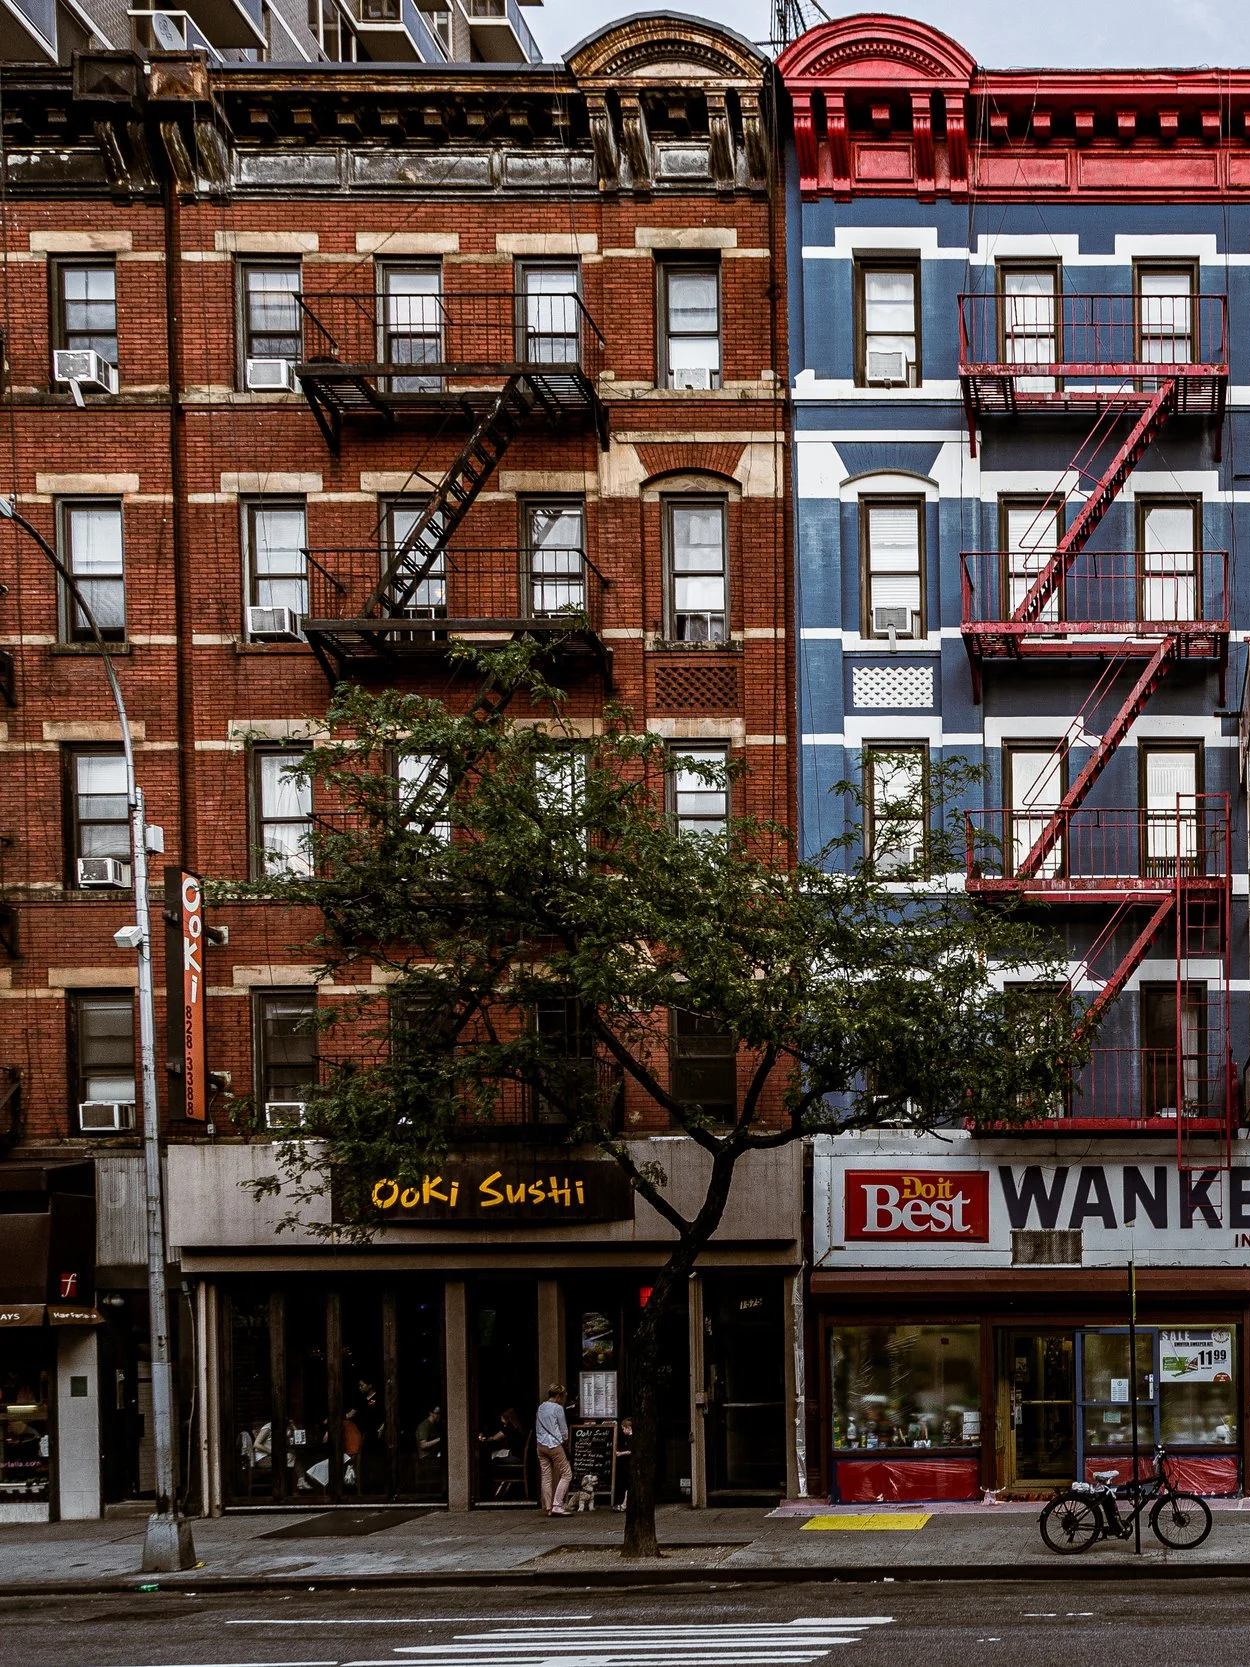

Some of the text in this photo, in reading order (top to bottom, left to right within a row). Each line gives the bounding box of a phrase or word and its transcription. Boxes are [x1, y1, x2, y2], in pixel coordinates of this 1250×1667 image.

[901, 1176, 954, 1199] Do it
[861, 1184, 971, 1232] Best
[1162, 1330, 1190, 1341] SALE
